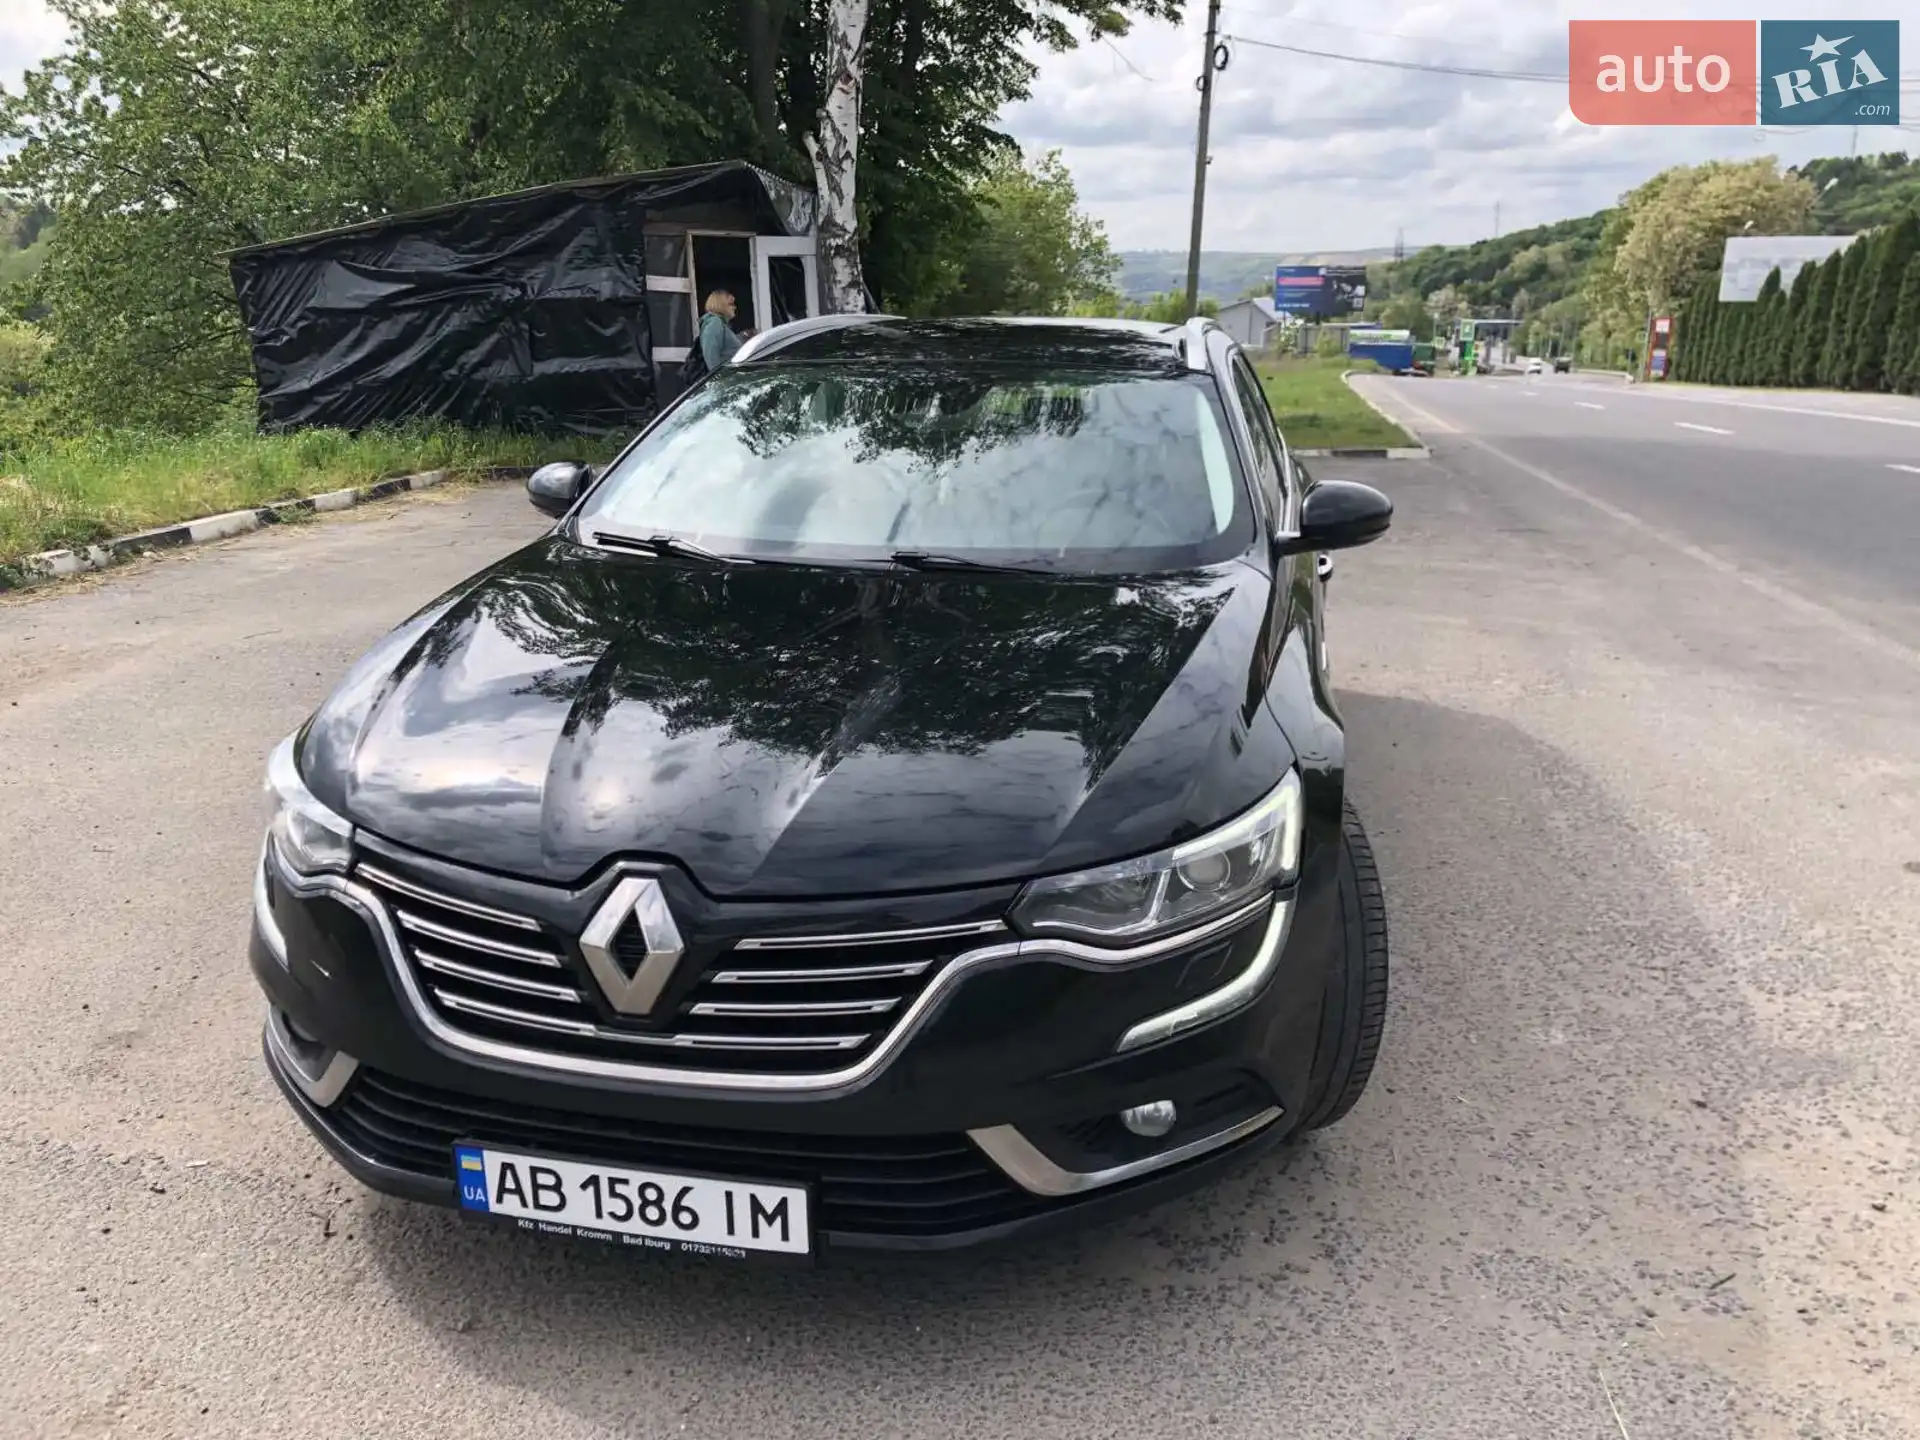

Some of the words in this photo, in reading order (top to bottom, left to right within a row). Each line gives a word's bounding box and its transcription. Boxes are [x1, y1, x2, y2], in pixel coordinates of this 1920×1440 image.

[464, 1185, 486, 1203] UA
[495, 1161, 567, 1213] AB
[579, 1173, 700, 1232] 1586
[724, 1189, 790, 1242] IM
[517, 1219, 534, 1230] Kfz
[538, 1221, 572, 1236] Handel
[622, 1234, 642, 1246] Bad
